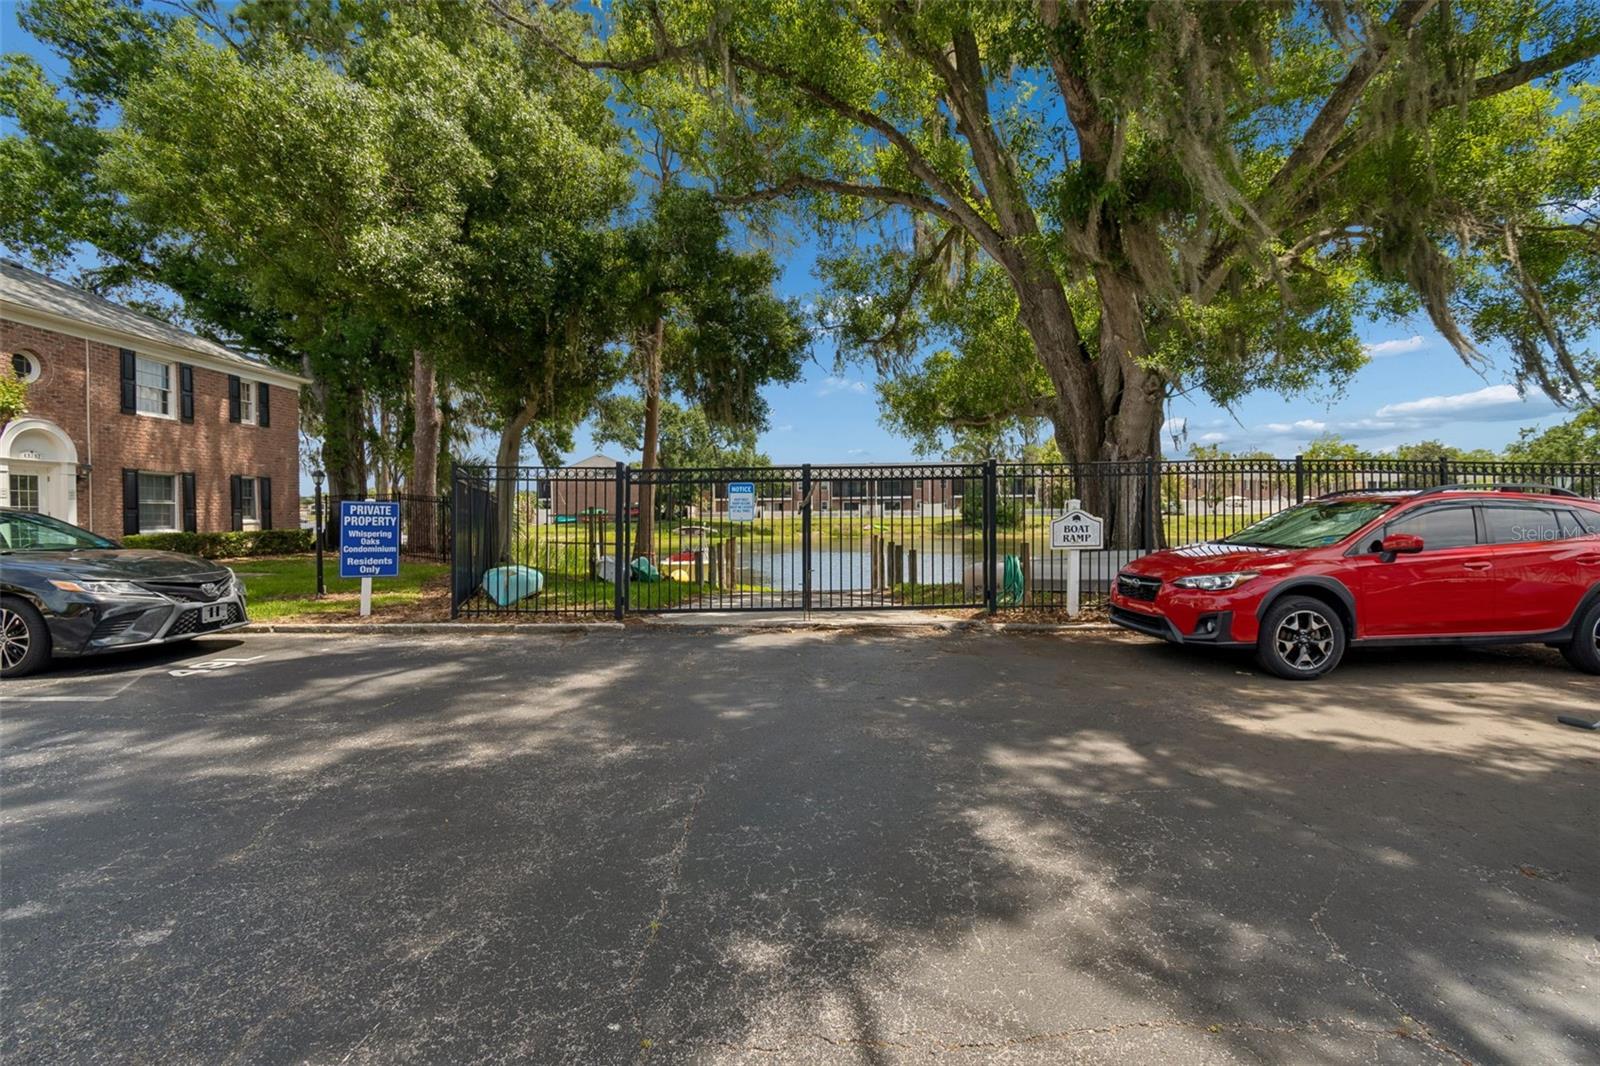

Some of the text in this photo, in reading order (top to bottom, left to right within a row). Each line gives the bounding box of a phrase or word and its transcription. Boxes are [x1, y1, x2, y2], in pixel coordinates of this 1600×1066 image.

[350, 505, 391, 515] PRIVATE
[344, 516, 396, 526] PROPERTY
[1063, 525, 1089, 533] BOAT
[348, 530, 392, 538] Whispering
[1063, 534, 1091, 542] RAMP
[359, 566, 380, 574] Only
